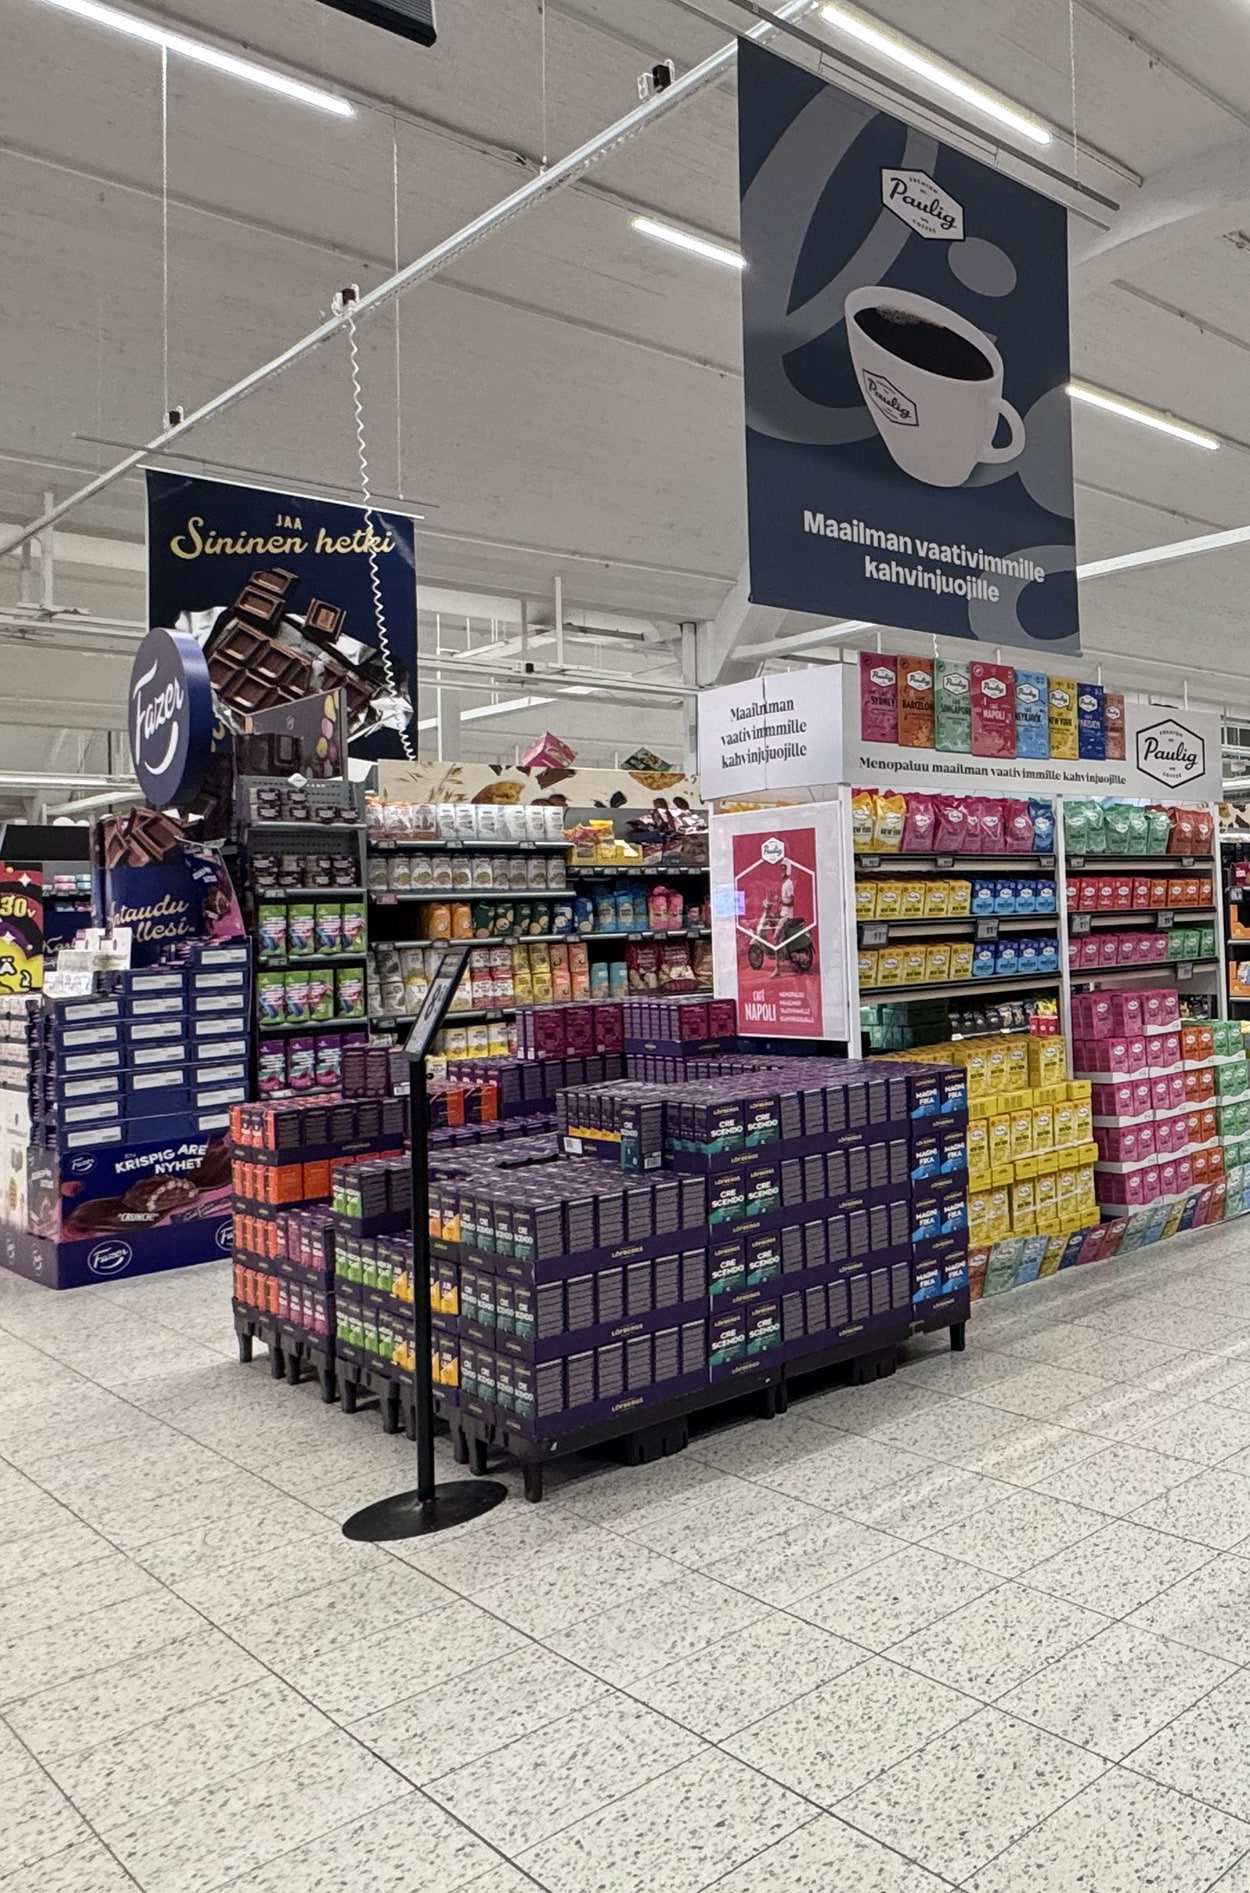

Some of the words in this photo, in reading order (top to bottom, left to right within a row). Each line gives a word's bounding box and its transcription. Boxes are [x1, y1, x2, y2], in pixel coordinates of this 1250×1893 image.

[889, 177, 957, 231] Paulig
[867, 377, 913, 419] Paulig
[275, 514, 303, 530] JAA
[170, 516, 308, 560] Sininen
[315, 527, 396, 554] hetki
[803, 510, 913, 554] Maailman
[915, 538, 1046, 583] vaativimmille
[864, 556, 1000, 602] kahvinjuojille
[132, 659, 185, 766] Fazer
[902, 699, 934, 712] BARCELON
[1144, 737, 1199, 771] Paulig
[859, 756, 930, 776] Menopaluu
[932, 760, 988, 776] maailman
[990, 764, 1061, 781] vaativimmille
[1063, 770, 1127, 786] kahvinjuojille
[745, 1003, 777, 1022] NAPOLI
[710, 1125, 744, 1138] SCENDO
[747, 1119, 779, 1131] SCENDO
[154, 1158, 203, 1174] NYHET
[711, 1195, 745, 1208] SCENDO
[748, 1186, 779, 1200] SCENDO
[93, 1246, 129, 1270] Fazer
[749, 1255, 780, 1270] SCENDO
[711, 1264, 745, 1279] SCENDO
